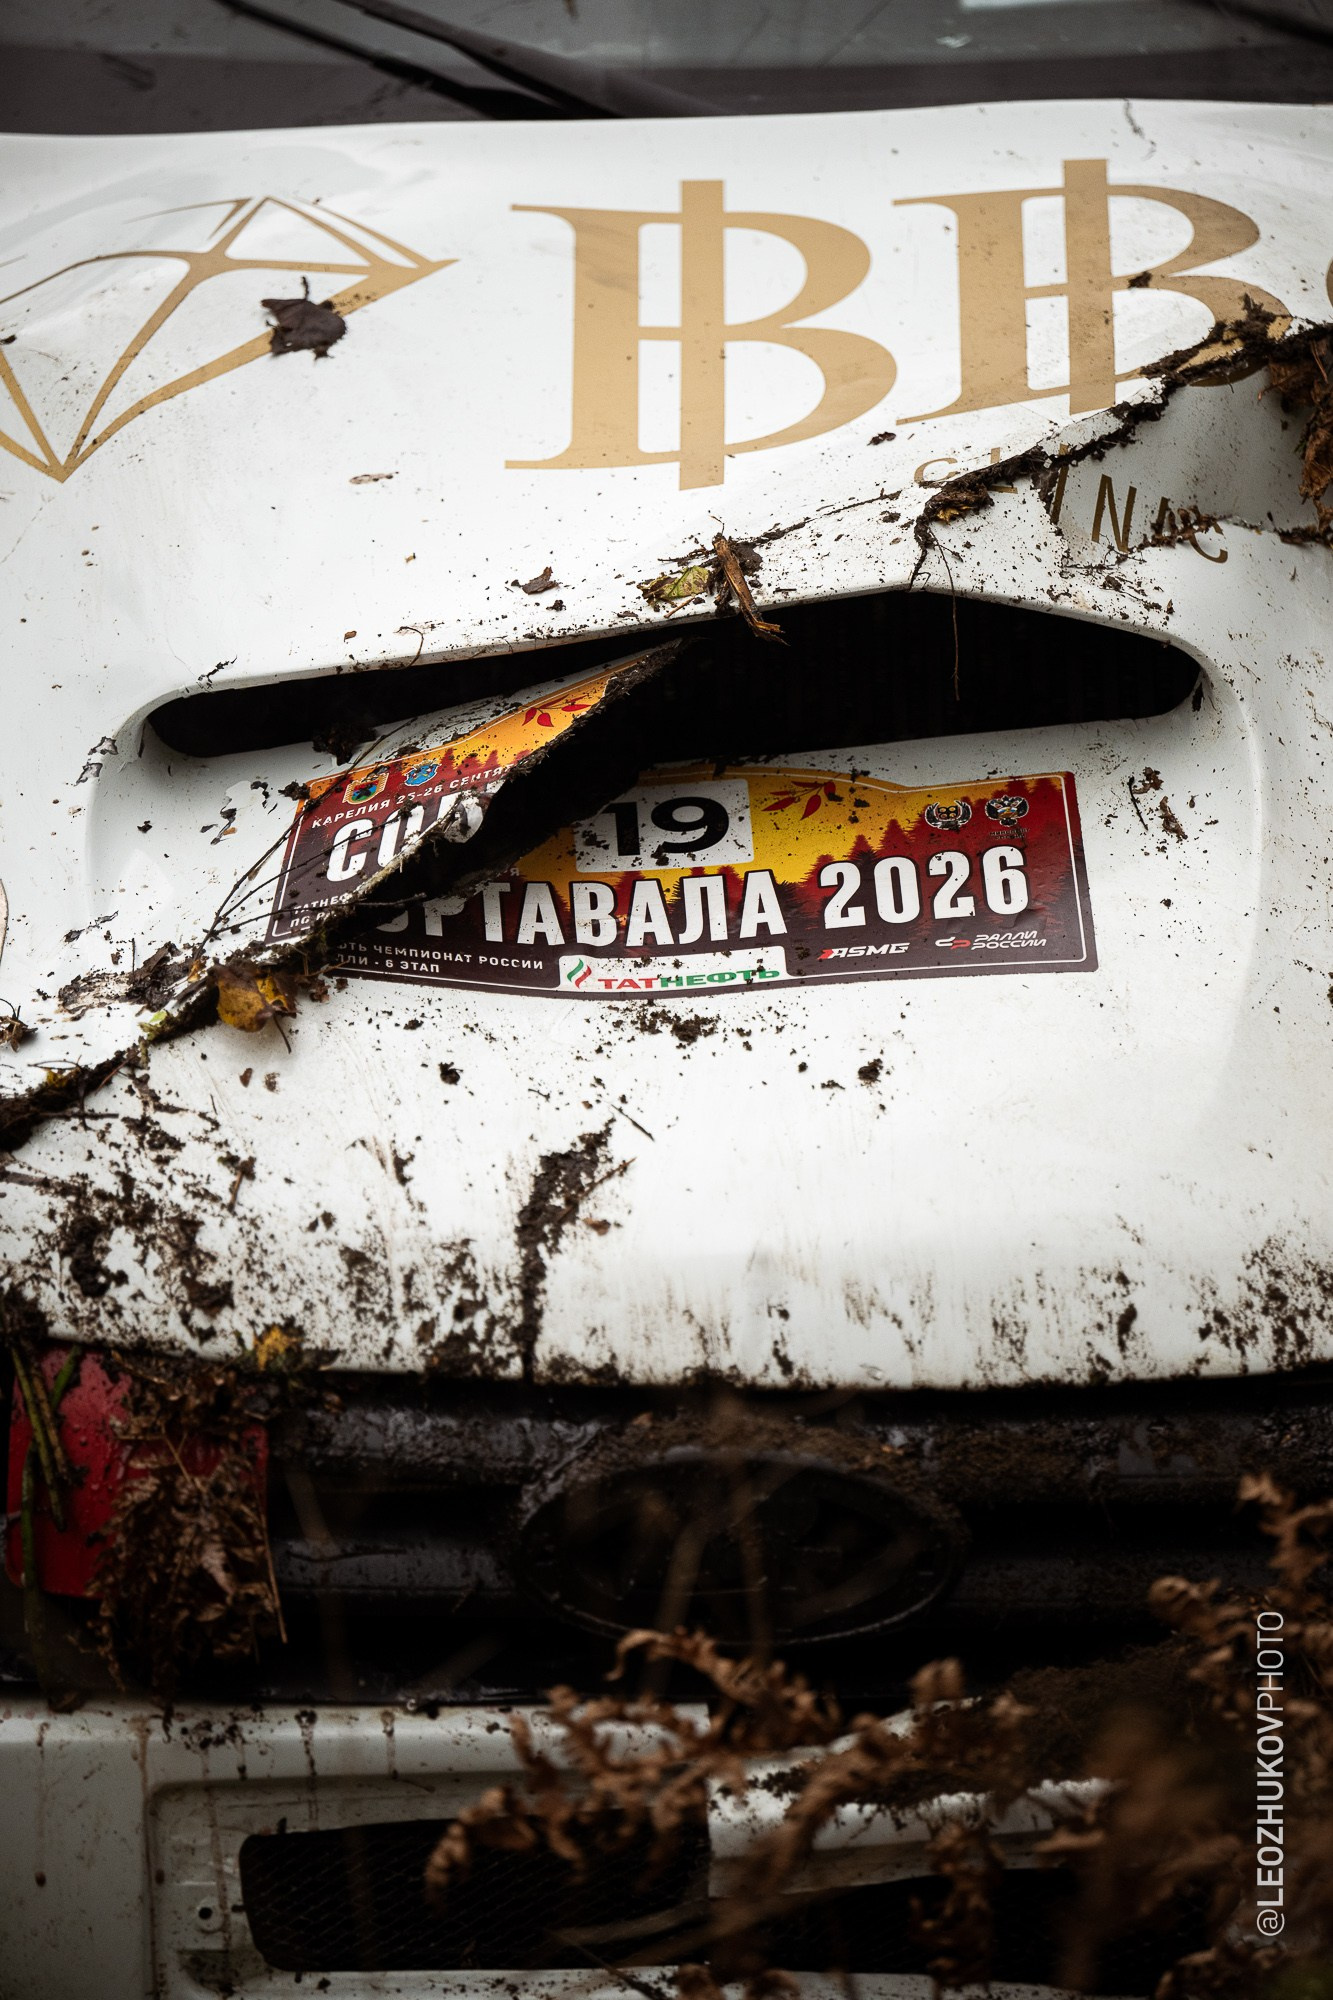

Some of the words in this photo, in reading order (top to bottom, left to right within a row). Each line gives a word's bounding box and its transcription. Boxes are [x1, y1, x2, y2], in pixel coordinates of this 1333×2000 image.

[311, 799, 391, 829] КАРЕЛИЯ
[396, 784, 443, 805] 25-26
[600, 796, 729, 857] 19
[819, 845, 1029, 930] 2026
[971, 938, 1047, 951] РОССИИ
[974, 930, 1038, 943] РАЛЛИ
[373, 944, 472, 963] ЧЕМПИОНАТ
[479, 955, 544, 970] РОССИИ
[385, 959, 394, 968] 6
[400, 960, 440, 973] ЭТАП
[598, 968, 780, 990] ТАТНЕФТЬ
